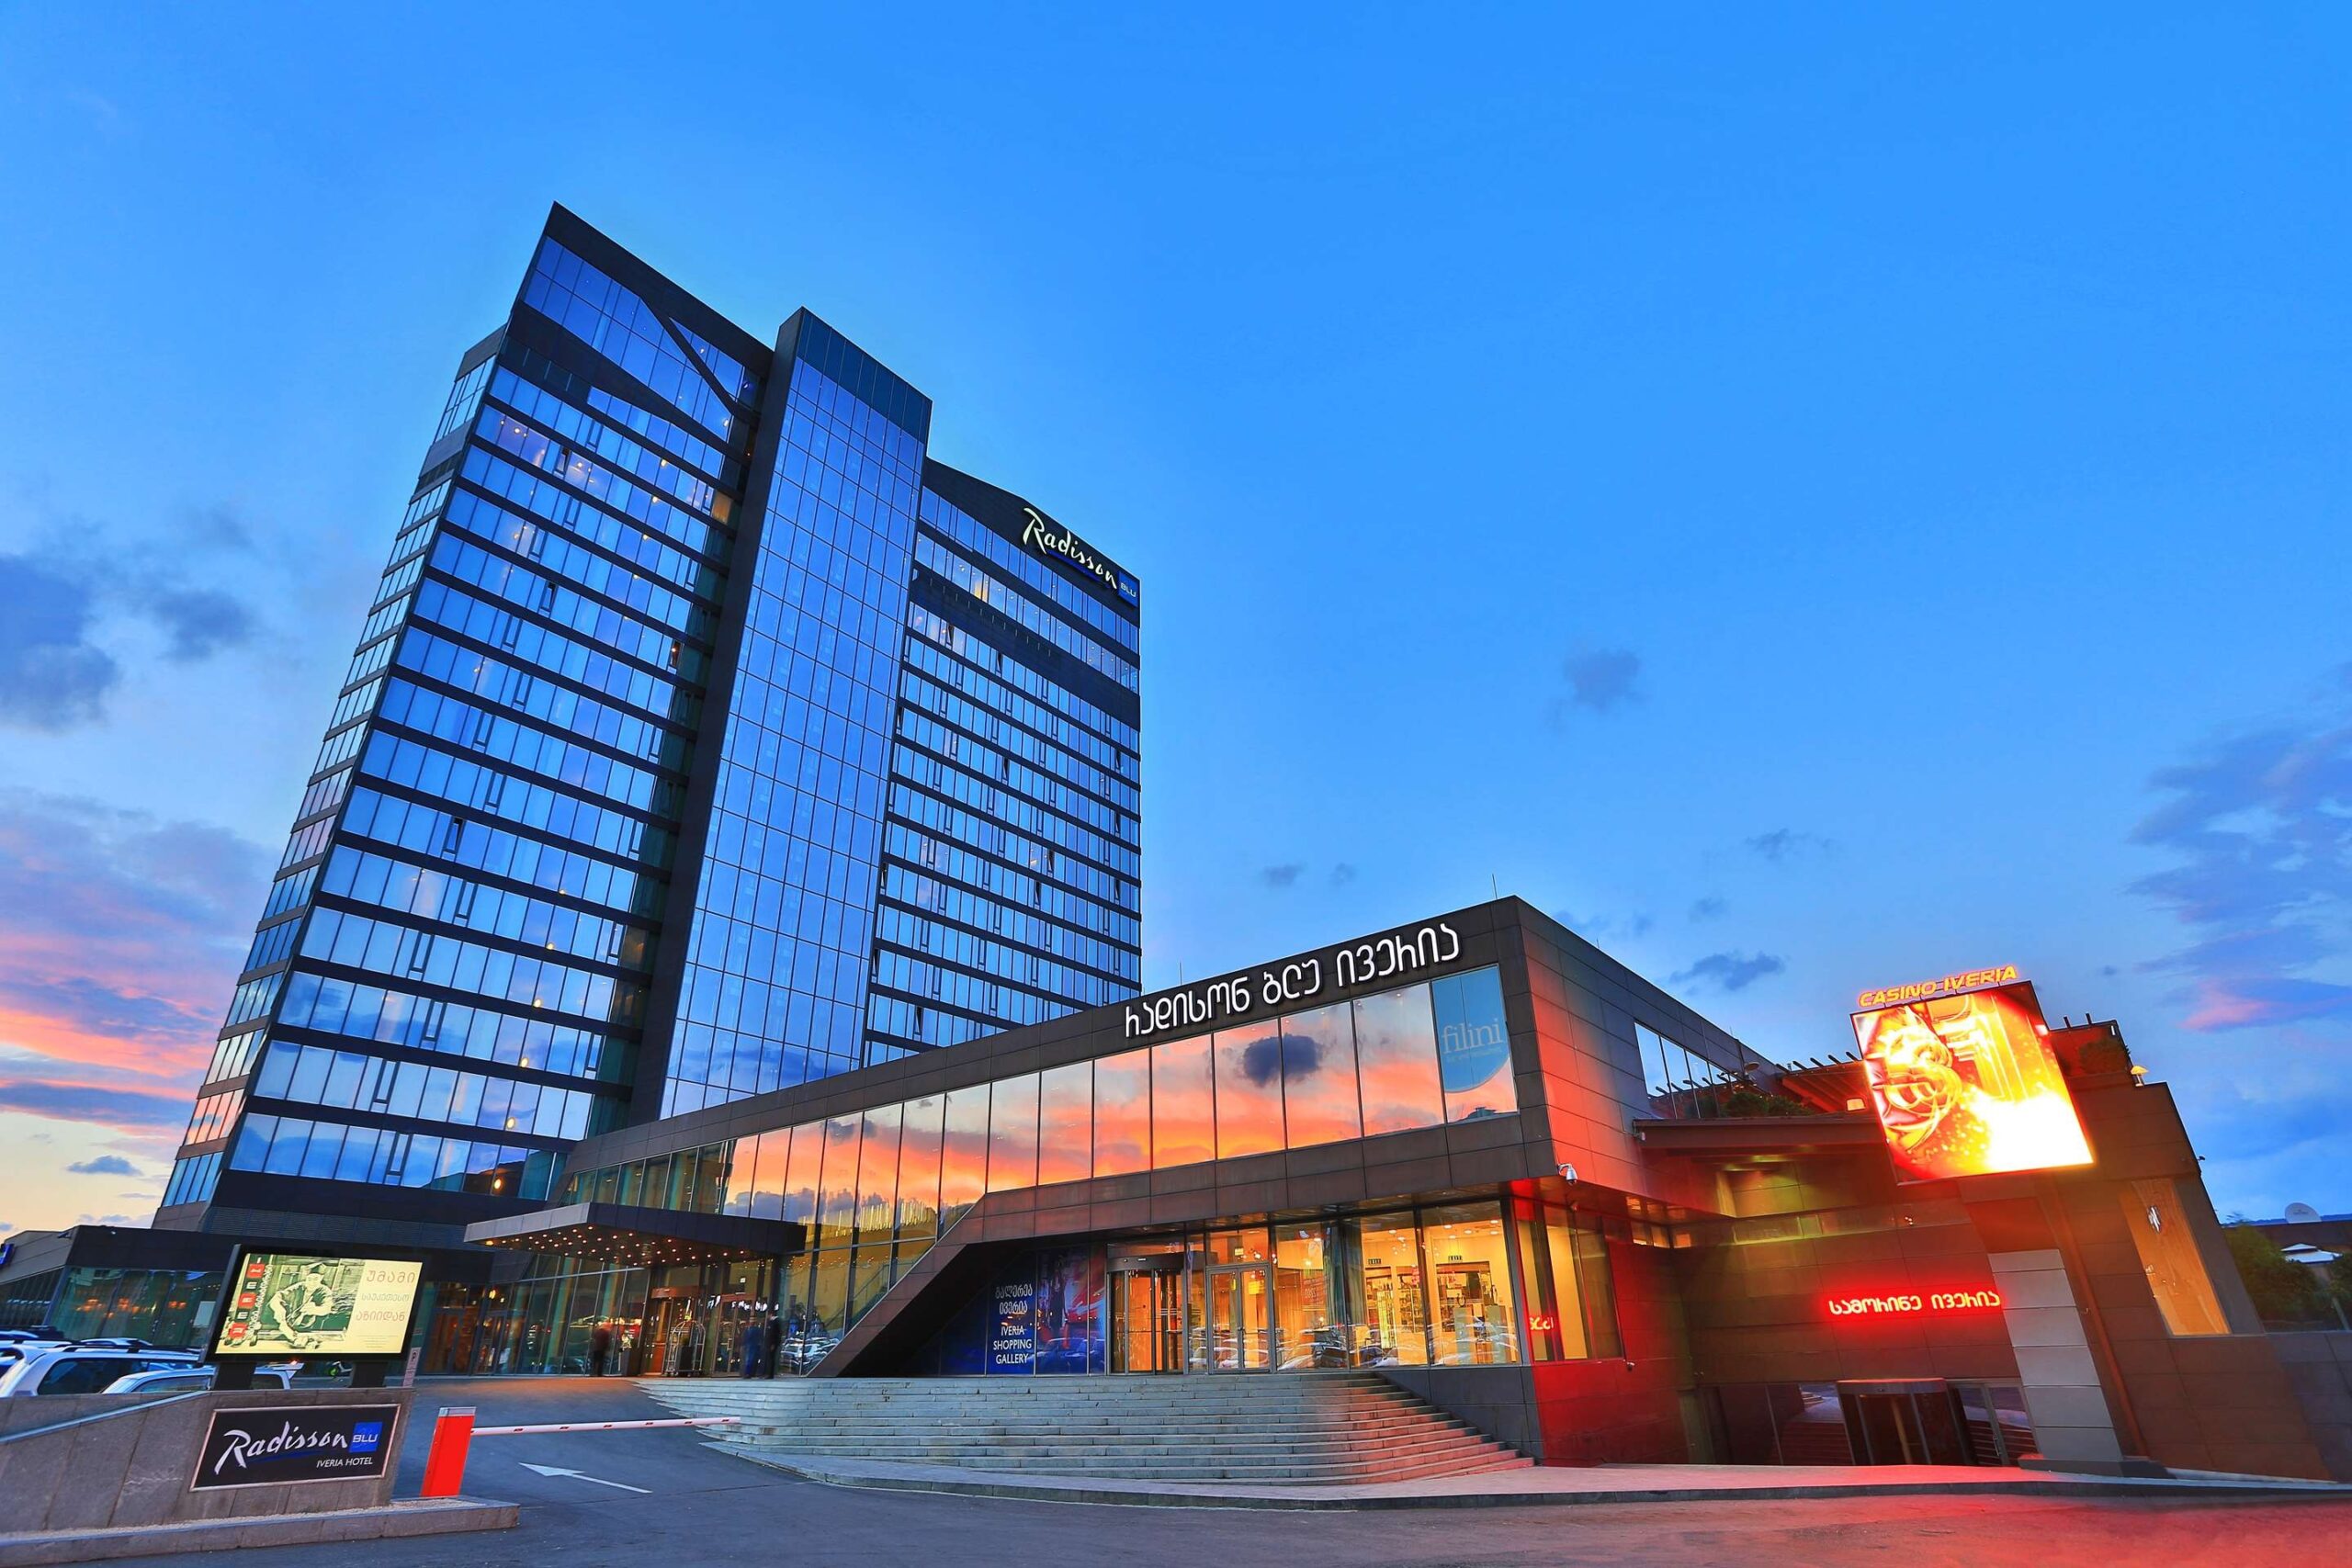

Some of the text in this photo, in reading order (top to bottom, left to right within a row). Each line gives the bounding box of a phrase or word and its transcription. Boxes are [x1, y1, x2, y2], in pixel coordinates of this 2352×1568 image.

[1023, 507, 1136, 598] Radisson BLU
[1125, 922, 1460, 1038] რადისონ ბლუ ივერია
[1859, 965, 2018, 1008] CASINO IVERIA
[1442, 1017, 1504, 1055] filini
[368, 1269, 416, 1284] უმამი
[995, 1283, 1034, 1300] გალერეა
[999, 1300, 1028, 1315] ივერია
[1828, 1290, 2001, 1315] სამორინე ივერია
[1001, 1325, 1025, 1337] IVERIA
[993, 1338, 1033, 1350] SHOPPING
[995, 1353, 1029, 1365] GALLERY
[214, 1420, 379, 1475] Radisson BLU
[316, 1456, 373, 1469] IVERIA HOTEL
